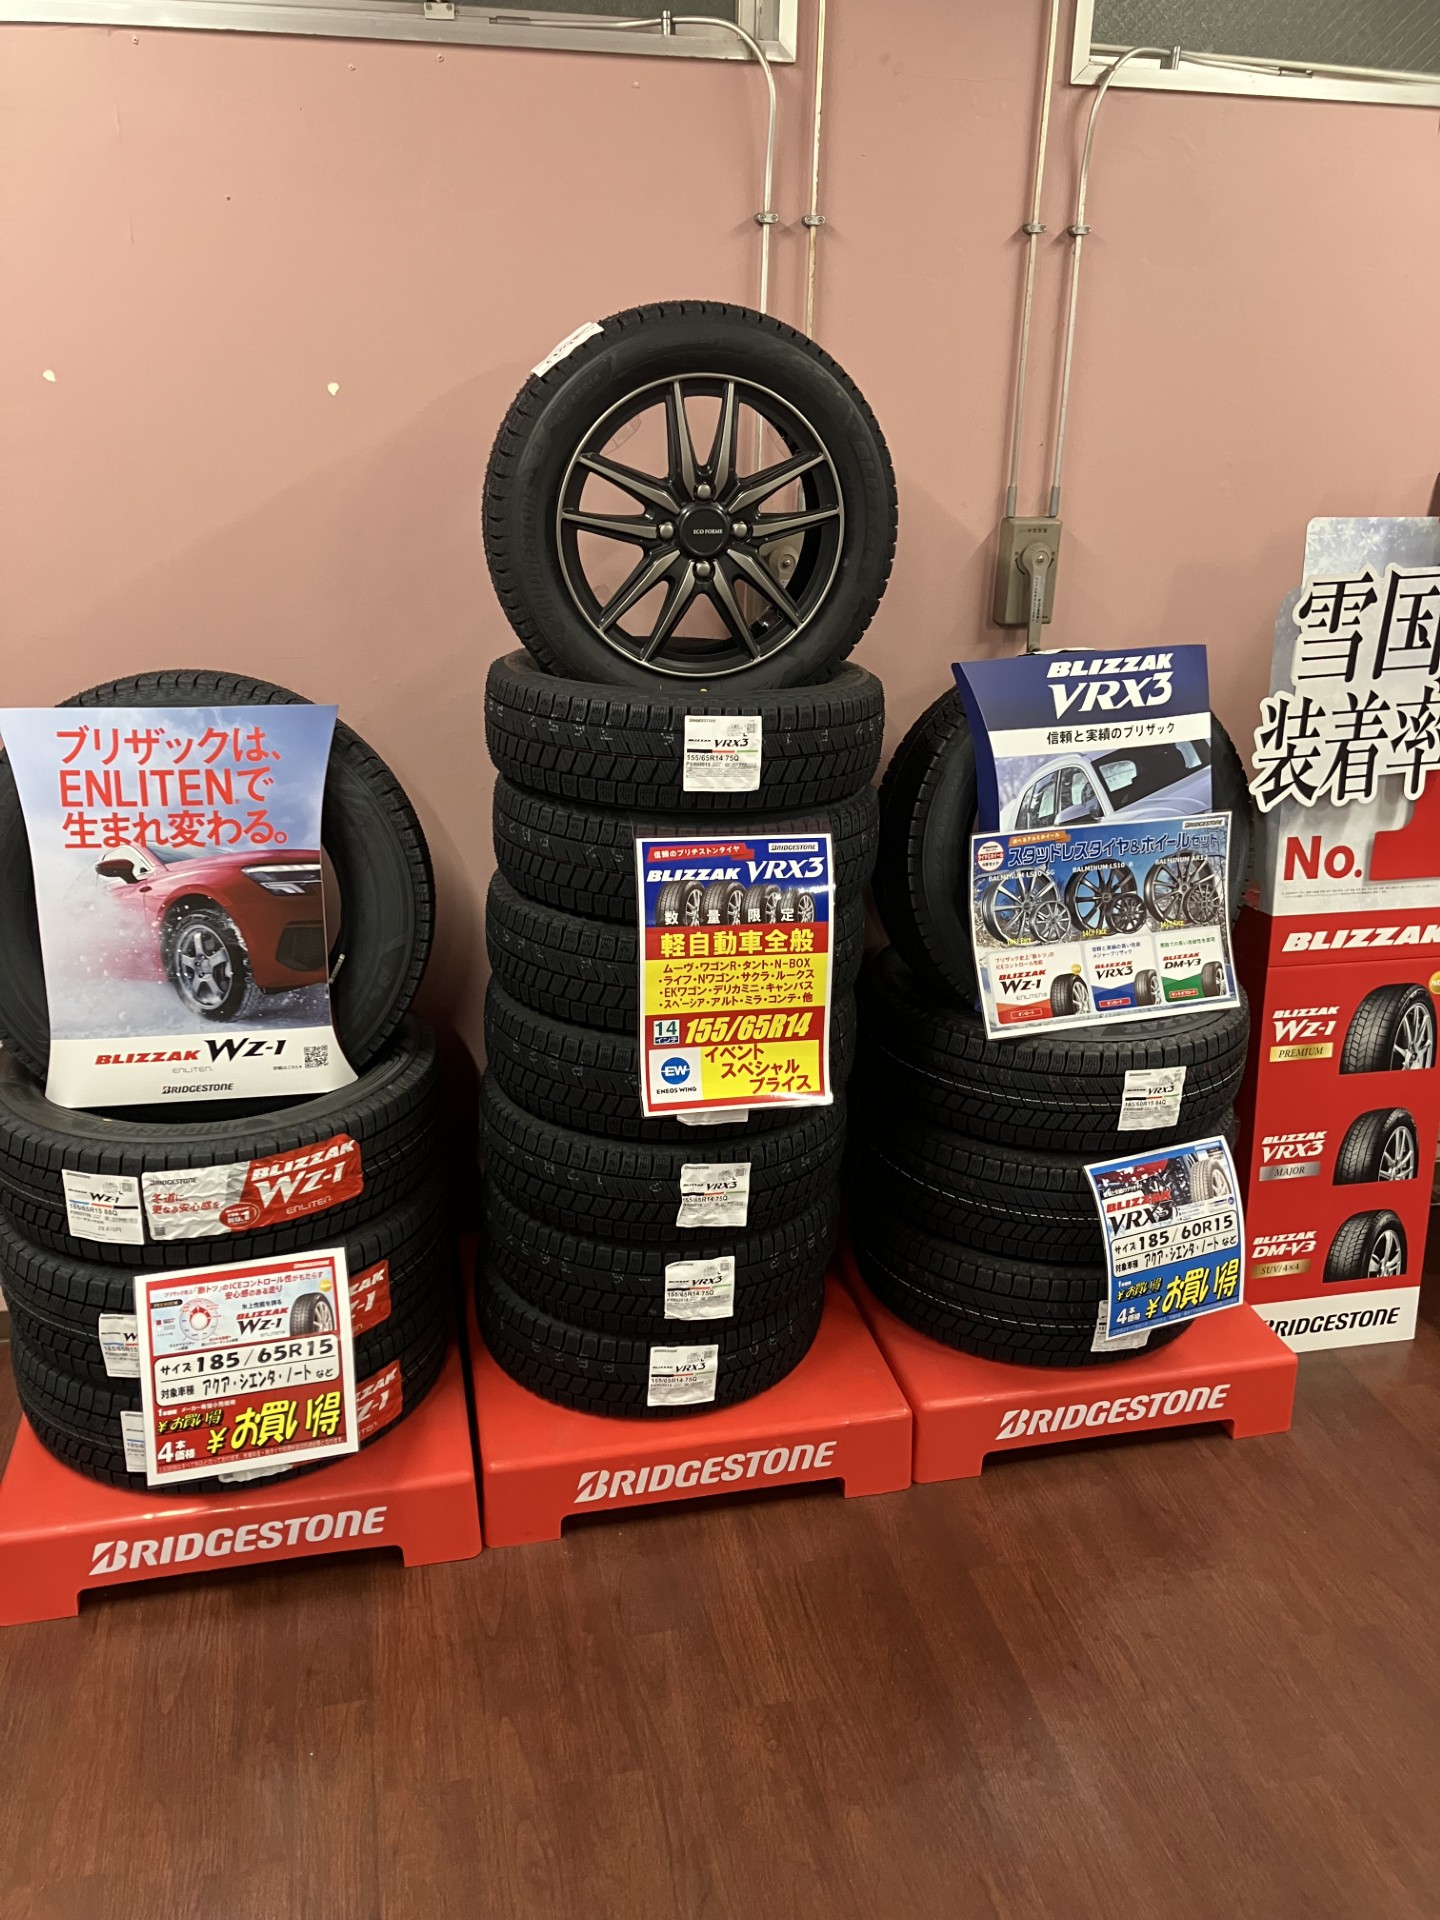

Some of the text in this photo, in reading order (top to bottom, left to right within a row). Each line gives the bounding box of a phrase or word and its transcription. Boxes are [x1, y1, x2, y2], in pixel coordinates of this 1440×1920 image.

[1046, 653, 1174, 678] BLIZZAK
[1047, 671, 1174, 720] VRX3
[1047, 722, 1175, 745] 信頼と実績のブリザック
[56, 725, 281, 766] ブリザックは、
[714, 738, 749, 748] VRX3
[687, 754, 723, 762] 155/65R14
[62, 810, 288, 849] 生まれ変わる。
[771, 844, 816, 852] BRIDGESTONE
[1008, 832, 1217, 867] スタッドレスタイヤ&ホイールセット
[647, 857, 825, 883] BLIZZAK VRX3
[1109, 861, 1125, 869] LS10
[661, 928, 814, 958] 軽自動車全般
[1095, 961, 1133, 969] BLIZZAK
[1163, 952, 1200, 961] BLIZZAK
[1164, 958, 1201, 970] DM-V3
[999, 969, 1046, 980] BLIZZAK
[1096, 966, 1133, 980] VRX3
[1000, 979, 1041, 995] WZ-1
[1272, 1005, 1341, 1019] BLIZZAK
[655, 1012, 814, 1044] 14 155/65R14
[1273, 1018, 1337, 1043] WZ-1
[655, 1037, 678, 1045] インチ
[95, 1038, 287, 1065] BLIZZAK WZ-1
[705, 1043, 764, 1063] イベント
[1278, 1046, 1324, 1059] PREMIUM
[664, 1066, 688, 1077] EW
[721, 1059, 800, 1079] スペシャル
[162, 1083, 234, 1094] BRIDGESTONE
[656, 1086, 697, 1095] ENEOS WING
[750, 1075, 811, 1094] プライス
[1148, 1085, 1175, 1095] VRX3
[1262, 1130, 1328, 1145] BLIZZAK
[251, 1140, 356, 1182] BLIZZAK
[1262, 1141, 1325, 1164] VRX3
[1274, 1165, 1306, 1177] MAJOR
[253, 1161, 345, 1209] WZ-1
[707, 1181, 737, 1191] VRX3
[286, 1196, 332, 1215] ENLITEN
[1106, 1188, 1172, 1214] BLIZZAK
[1108, 1200, 1174, 1238] VRX3
[1222, 1235, 1237, 1246] など
[1252, 1230, 1317, 1245] BLIZZAK
[1115, 1242, 1137, 1254] サイズ
[1251, 1240, 1317, 1259] DM-V3
[691, 1275, 723, 1287] VRX3
[1161, 1258, 1240, 1313] お買い得
[236, 1307, 289, 1320] BLIZZAK
[237, 1318, 282, 1335] WZ-1
[160, 1362, 192, 1374] サイズ
[675, 1363, 706, 1373] VRX3
[161, 1385, 195, 1399] 対象車種
[316, 1368, 333, 1378] など
[170, 1409, 222, 1431] お買い得
[230, 1391, 341, 1450] お買い得
[995, 1383, 1230, 1441] BRIDGESTONE
[574, 1441, 837, 1504] BRIDGESTONE
[89, 1506, 387, 1576] BRIDGESTONE
